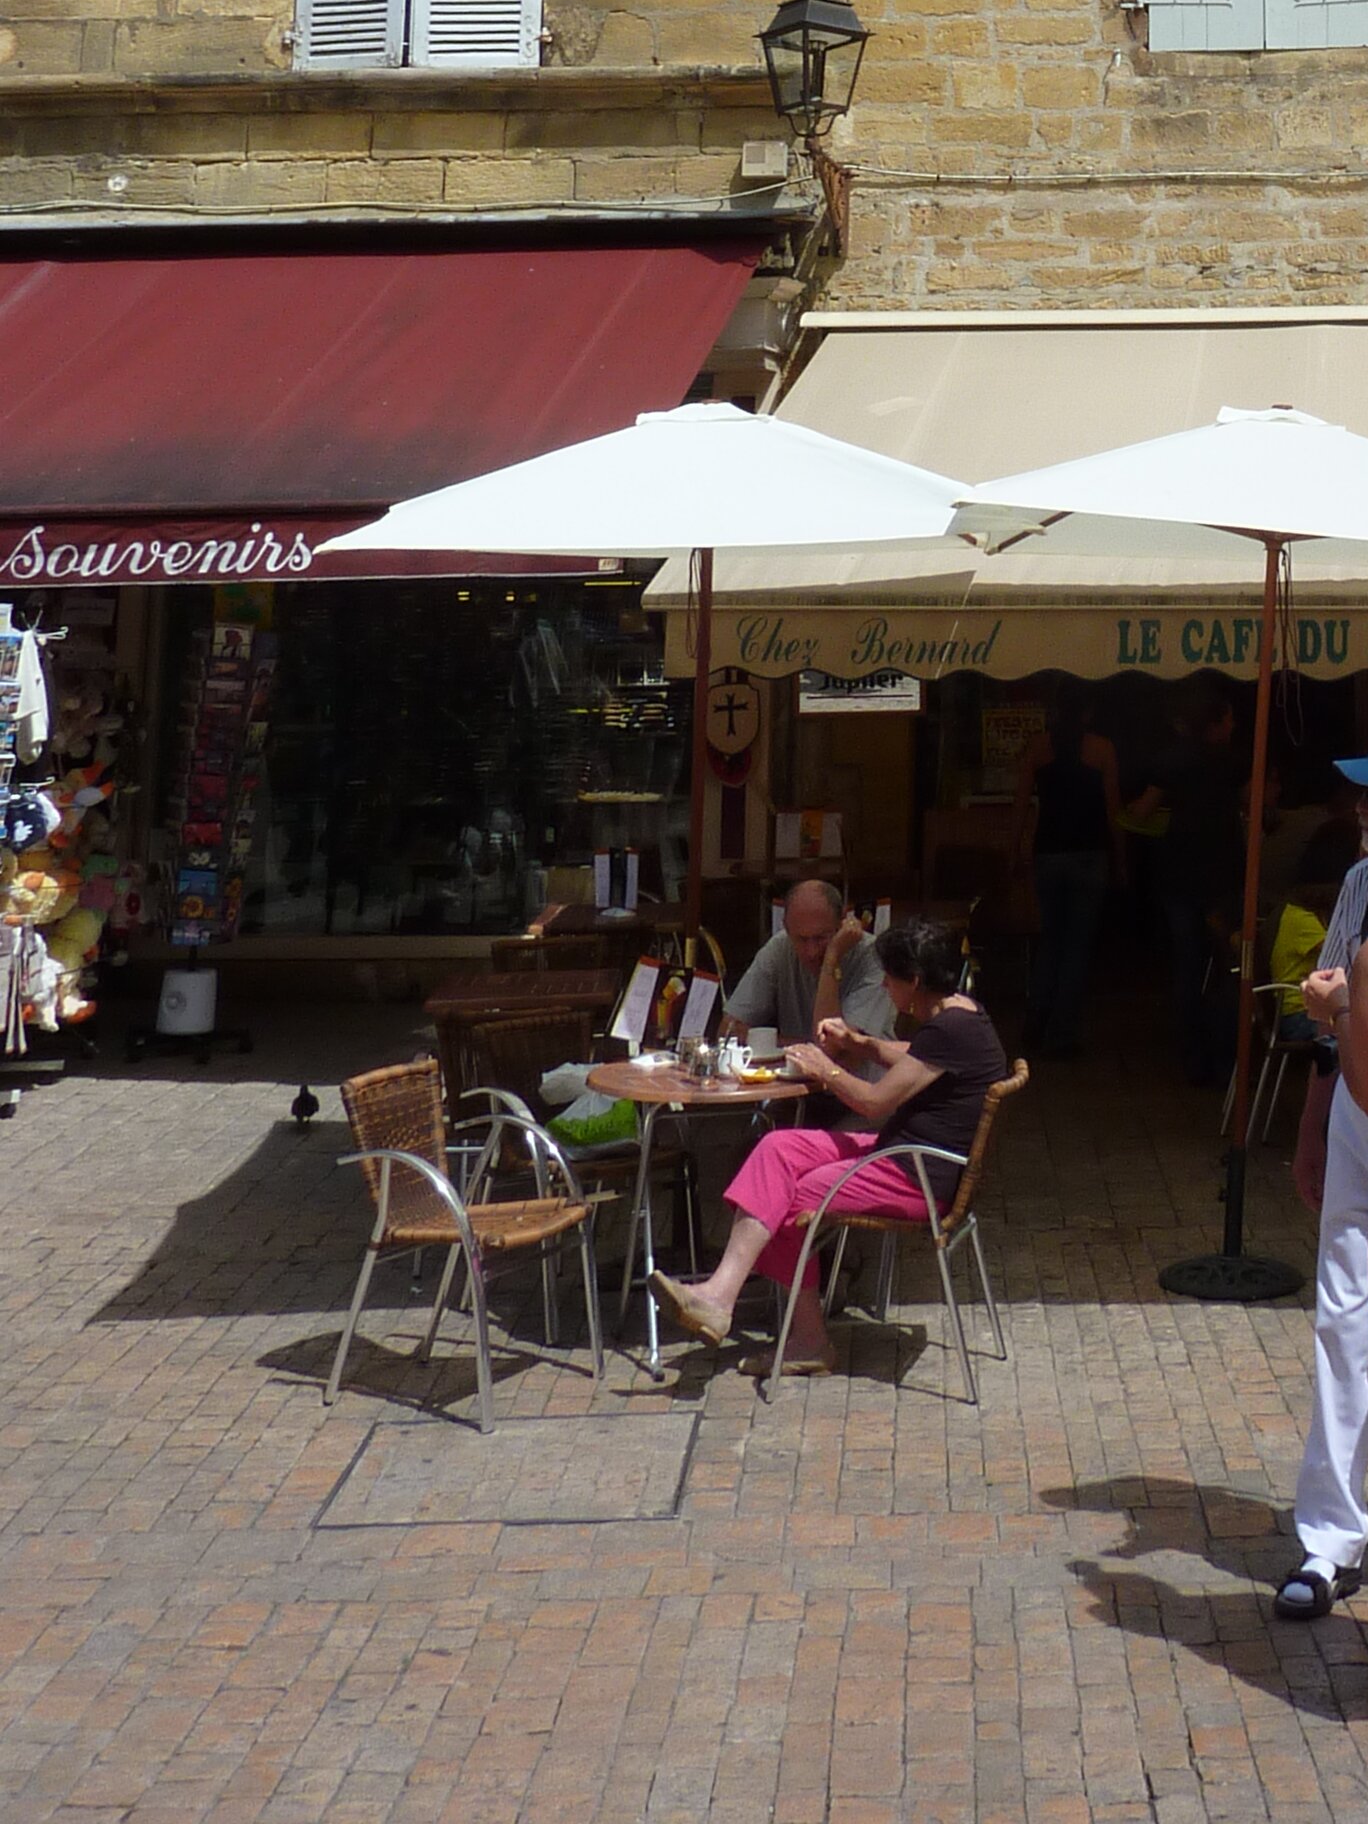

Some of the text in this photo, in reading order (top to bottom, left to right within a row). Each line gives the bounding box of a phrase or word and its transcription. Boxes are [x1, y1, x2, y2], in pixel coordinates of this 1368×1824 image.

[0, 523, 312, 578] Souvenirs
[736, 616, 1002, 665] Chez Bernard
[1118, 620, 1162, 664] LE
[1297, 620, 1350, 664] DU
